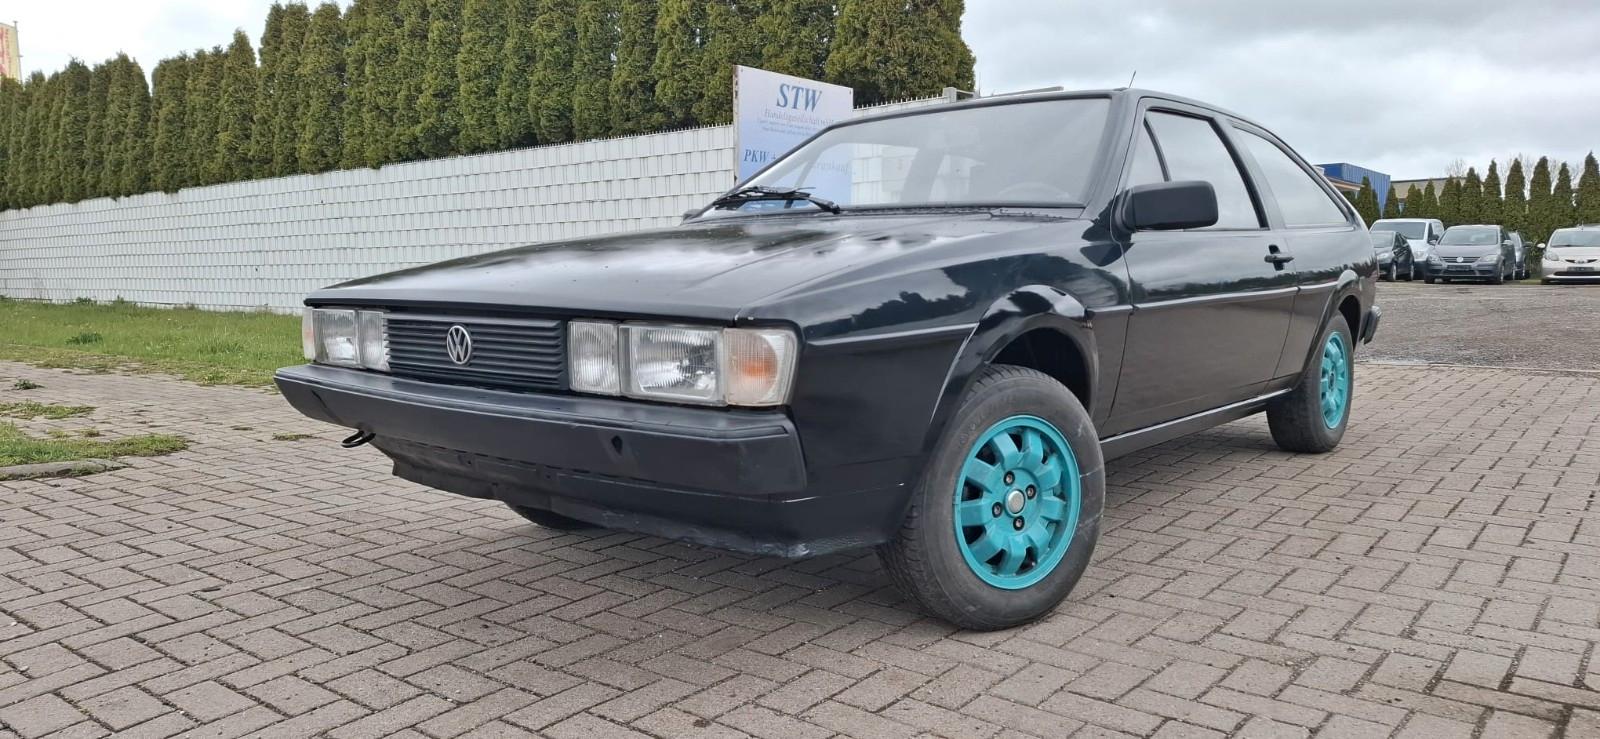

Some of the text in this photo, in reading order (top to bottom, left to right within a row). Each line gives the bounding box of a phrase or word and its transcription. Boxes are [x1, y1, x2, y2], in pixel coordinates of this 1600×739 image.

[777, 83, 822, 112] STW
[744, 149, 769, 163] PKW
[442, 326, 471, 364] VW
